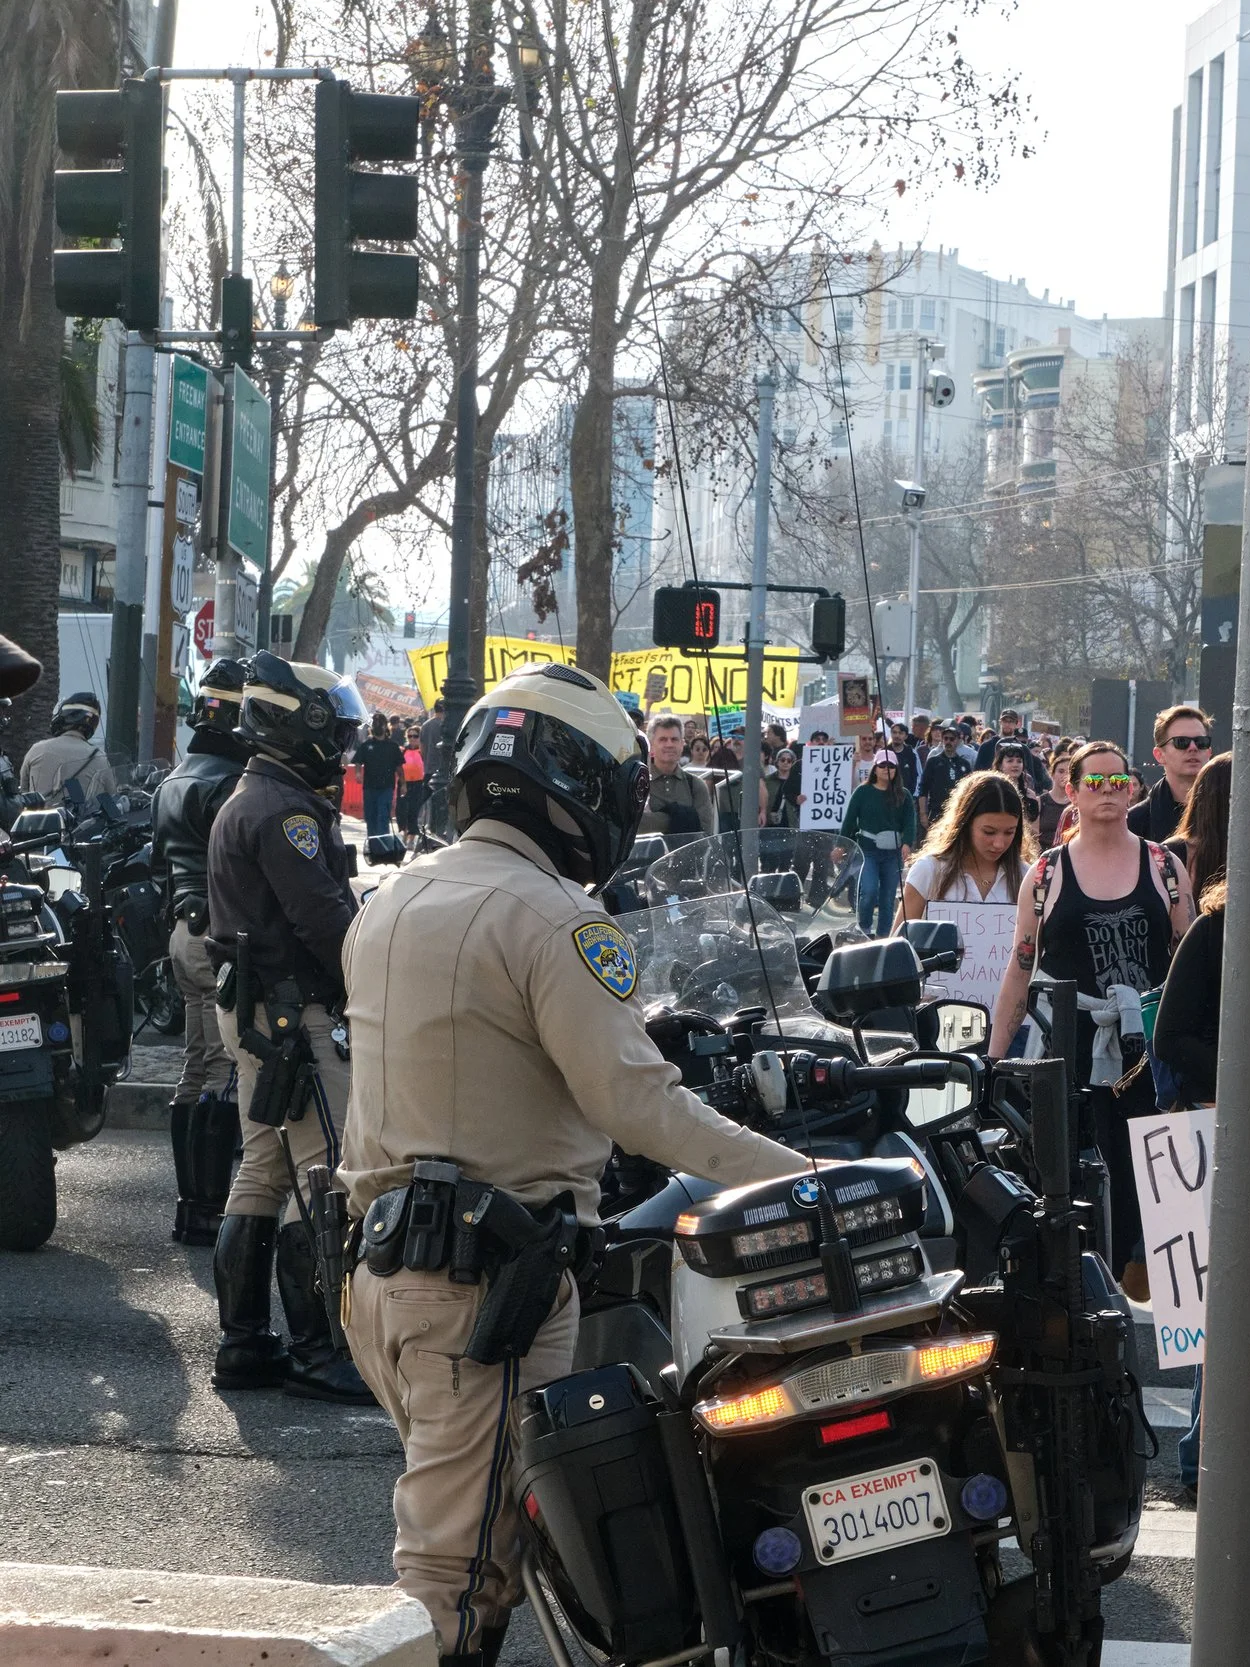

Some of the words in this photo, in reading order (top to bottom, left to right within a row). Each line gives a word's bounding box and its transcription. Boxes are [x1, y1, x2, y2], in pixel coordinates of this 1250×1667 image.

[179, 380, 206, 410] FREEWAY
[175, 420, 205, 450] ENTRANCE
[178, 488, 196, 516] SOUTH
[236, 476, 264, 531] ENTRANCE
[176, 564, 190, 603] 101
[197, 620, 214, 641] ST
[421, 648, 553, 692] TUMP
[647, 665, 692, 704] GO
[706, 666, 785, 705] NOW!
[492, 743, 513, 751] DOT
[813, 791, 846, 805] DHS
[814, 778, 842, 791] ICE
[1085, 926, 1111, 944] DO
[1125, 918, 1149, 938] NO
[1088, 938, 1150, 973] HARM
[0, 1017, 31, 1028] EXEMPT
[1143, 1125, 1208, 1204] FU
[1153, 1231, 1208, 1309] TH
[1160, 1325, 1206, 1356] POW
[822, 1489, 847, 1506] CA
[851, 1469, 918, 1499] EXEMPT
[823, 1492, 931, 1546] 3014007
